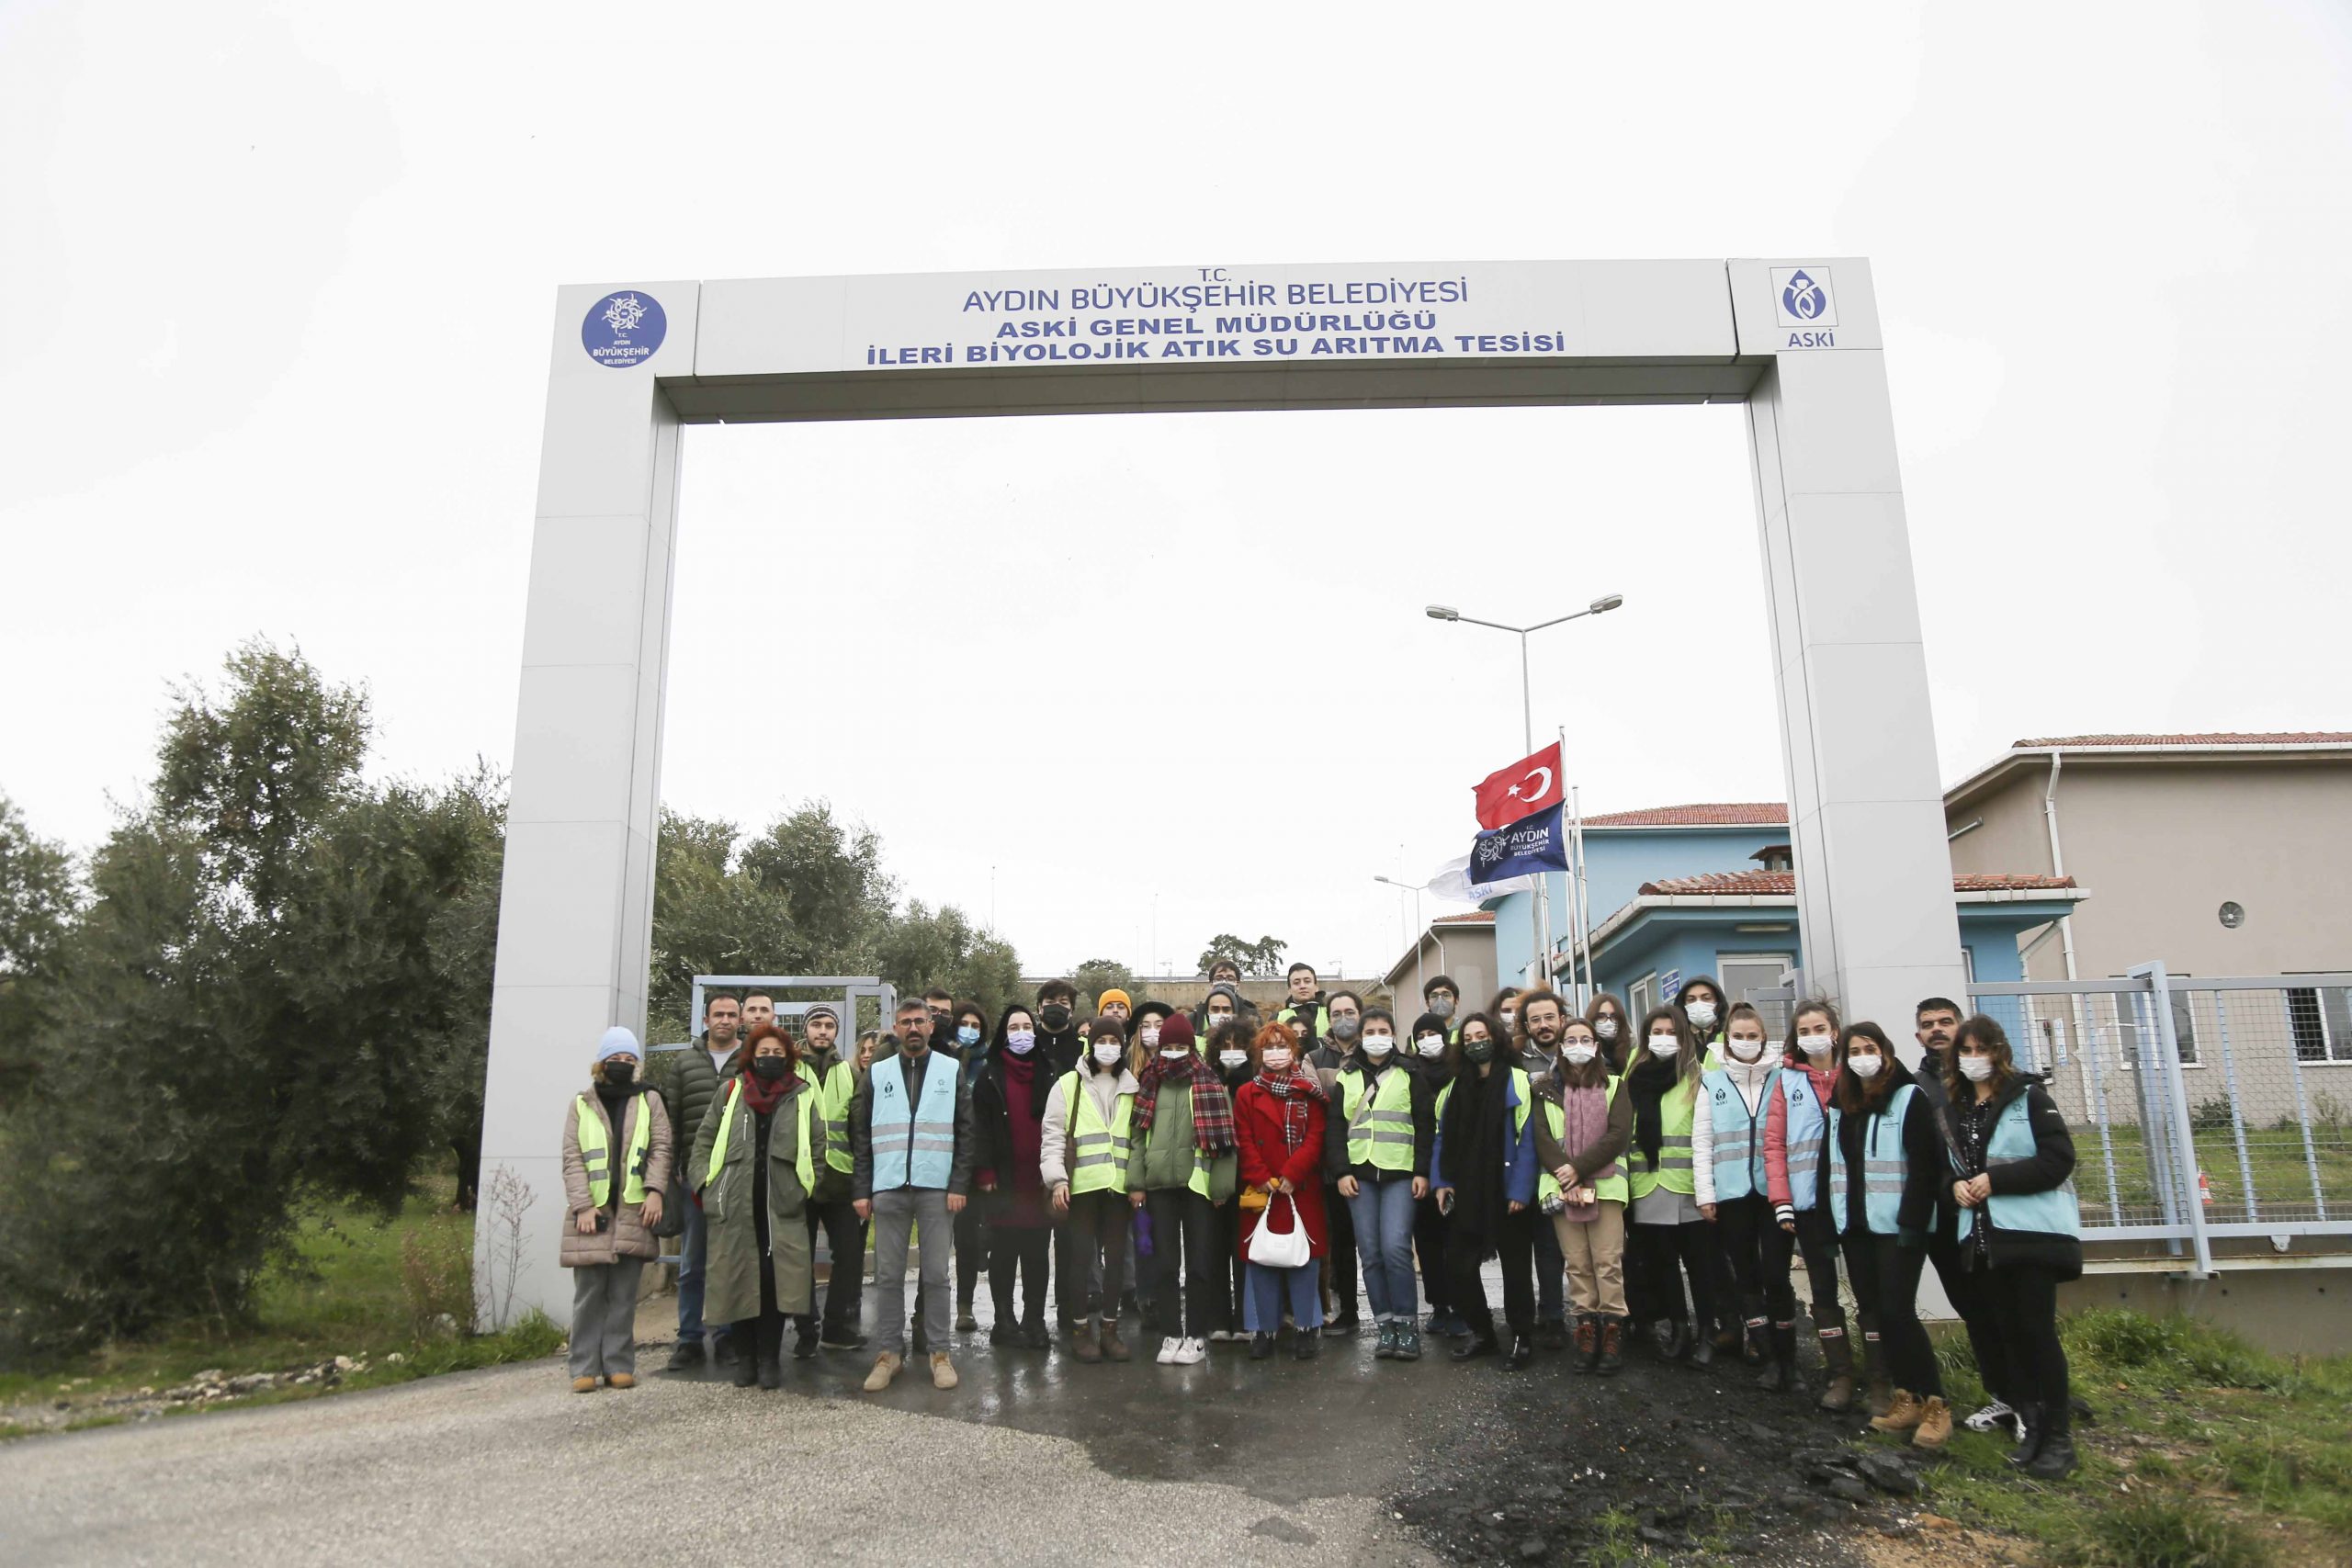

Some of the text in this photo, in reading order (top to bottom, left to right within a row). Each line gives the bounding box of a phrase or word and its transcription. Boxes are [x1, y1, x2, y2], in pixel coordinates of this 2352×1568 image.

[1197, 267, 1233, 283] T.C.
[963, 276, 1468, 313] AYDIN BÜYÜKŞEHİR BELEDİYESİ
[997, 310, 1437, 339] ASKİ GENEL MÜDÜRLÜĞÜ
[1788, 328, 1835, 347] ASKİ
[593, 346, 650, 357] BÜYÜKŞEHİR
[866, 330, 1566, 366] İLERİ BİYOLOJİK ATIK SU ARITMA TESİSİ
[1510, 827, 1549, 843] AYDIN
